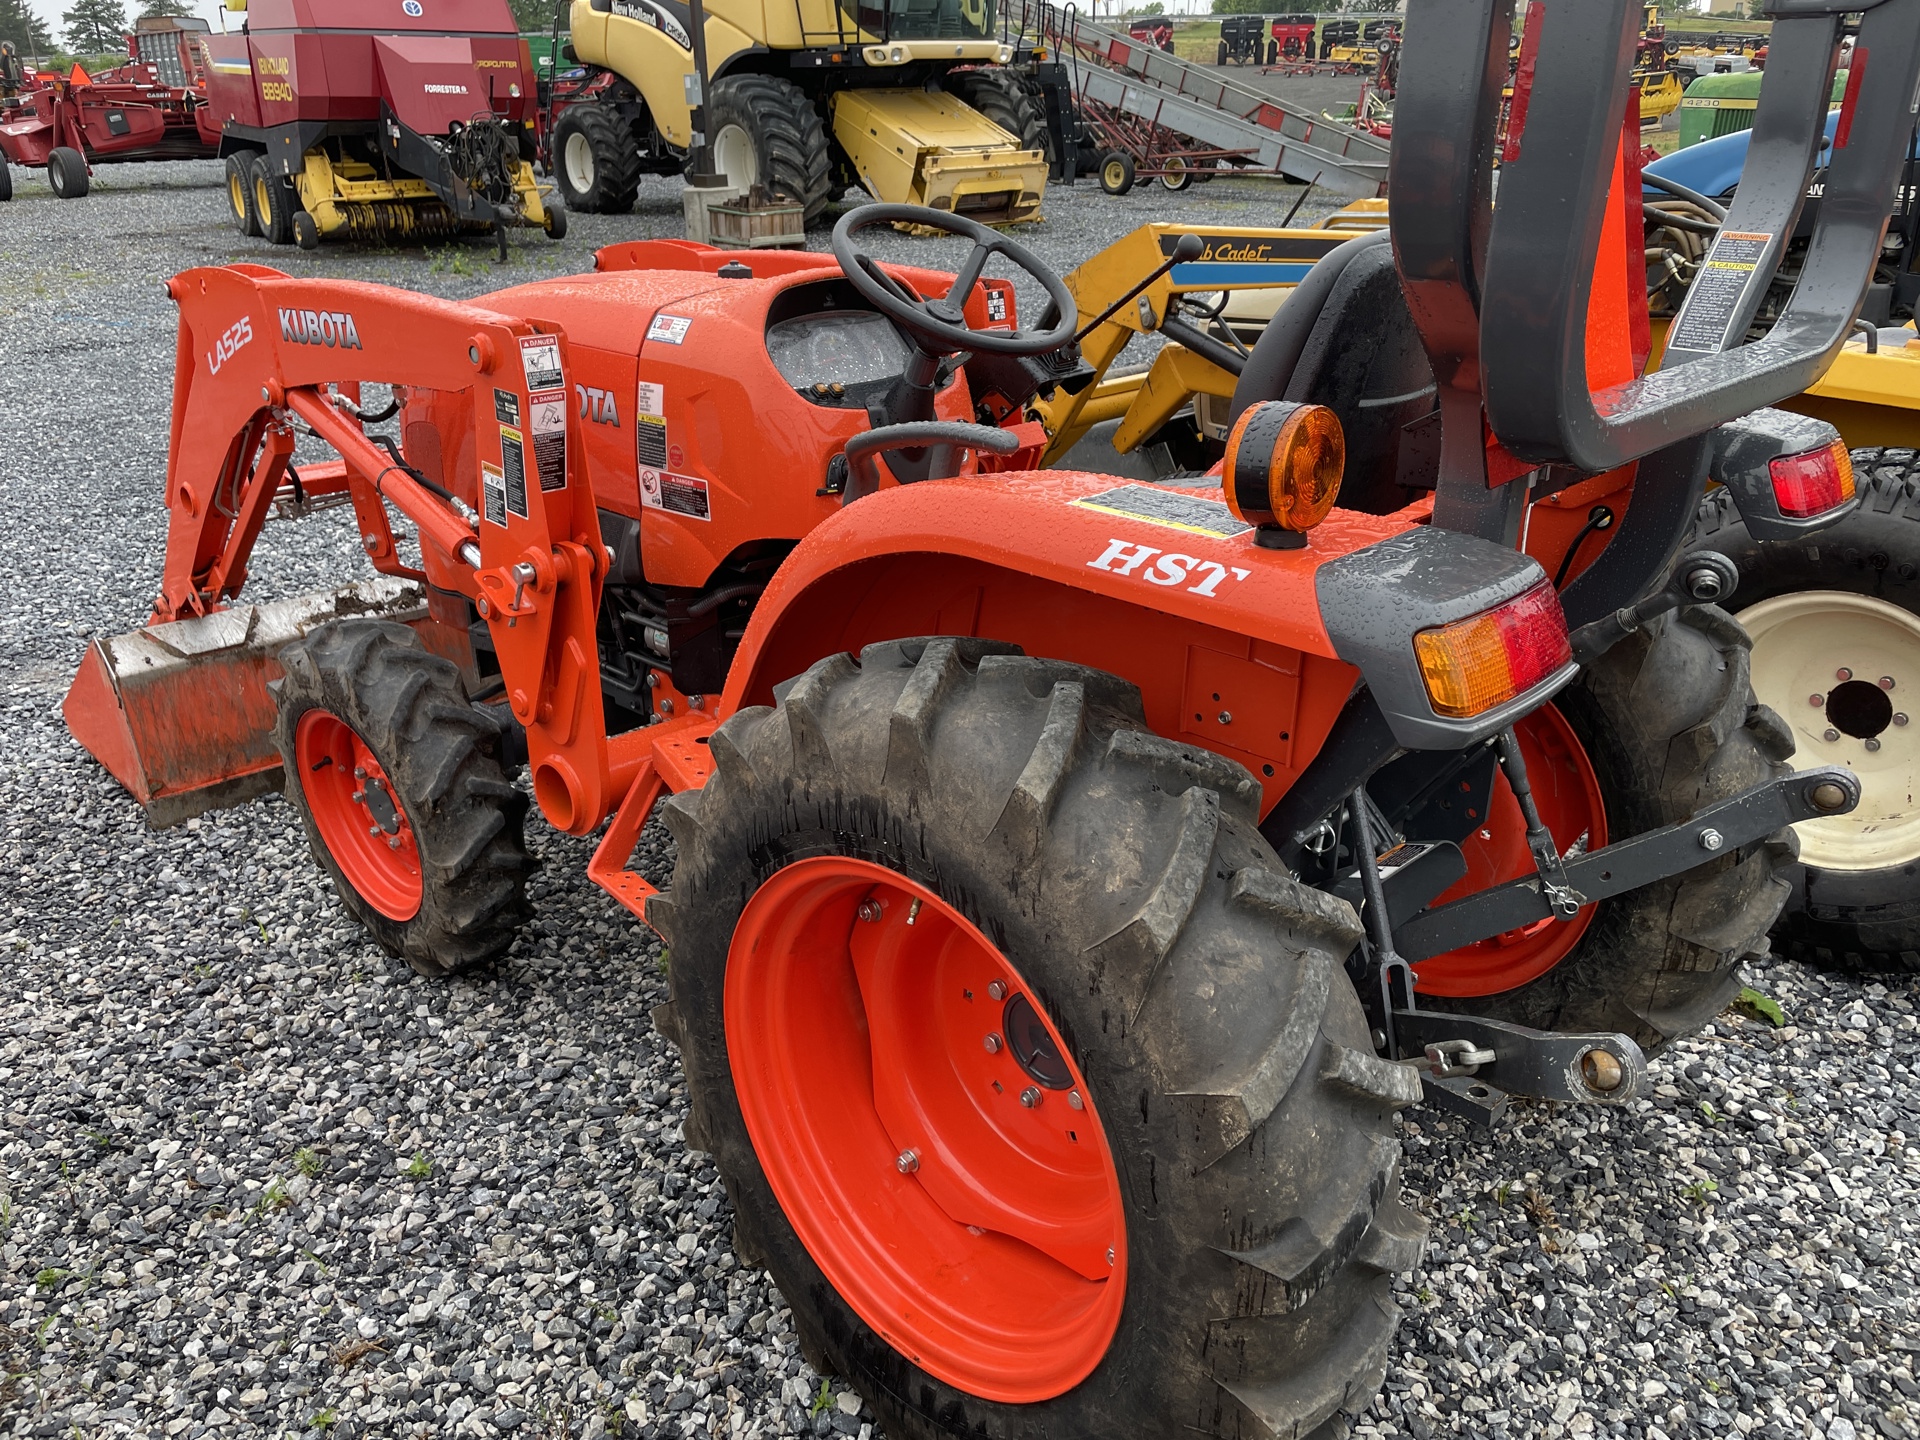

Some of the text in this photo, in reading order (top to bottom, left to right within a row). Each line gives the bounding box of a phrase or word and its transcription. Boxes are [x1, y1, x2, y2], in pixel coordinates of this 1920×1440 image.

[611, 1, 656, 26] New Holland
[262, 82, 292, 102] BB940
[424, 84, 460, 94] FORRESTER
[1215, 243, 1271, 261] Cadet
[278, 306, 362, 350] KUBOTA
[208, 316, 253, 375] LA525
[530, 338, 554, 346] DANGER
[539, 394, 562, 402] DANGER
[506, 430, 521, 440] CAUTION
[676, 477, 694, 486] DANGER
[1086, 539, 1252, 598] HST
